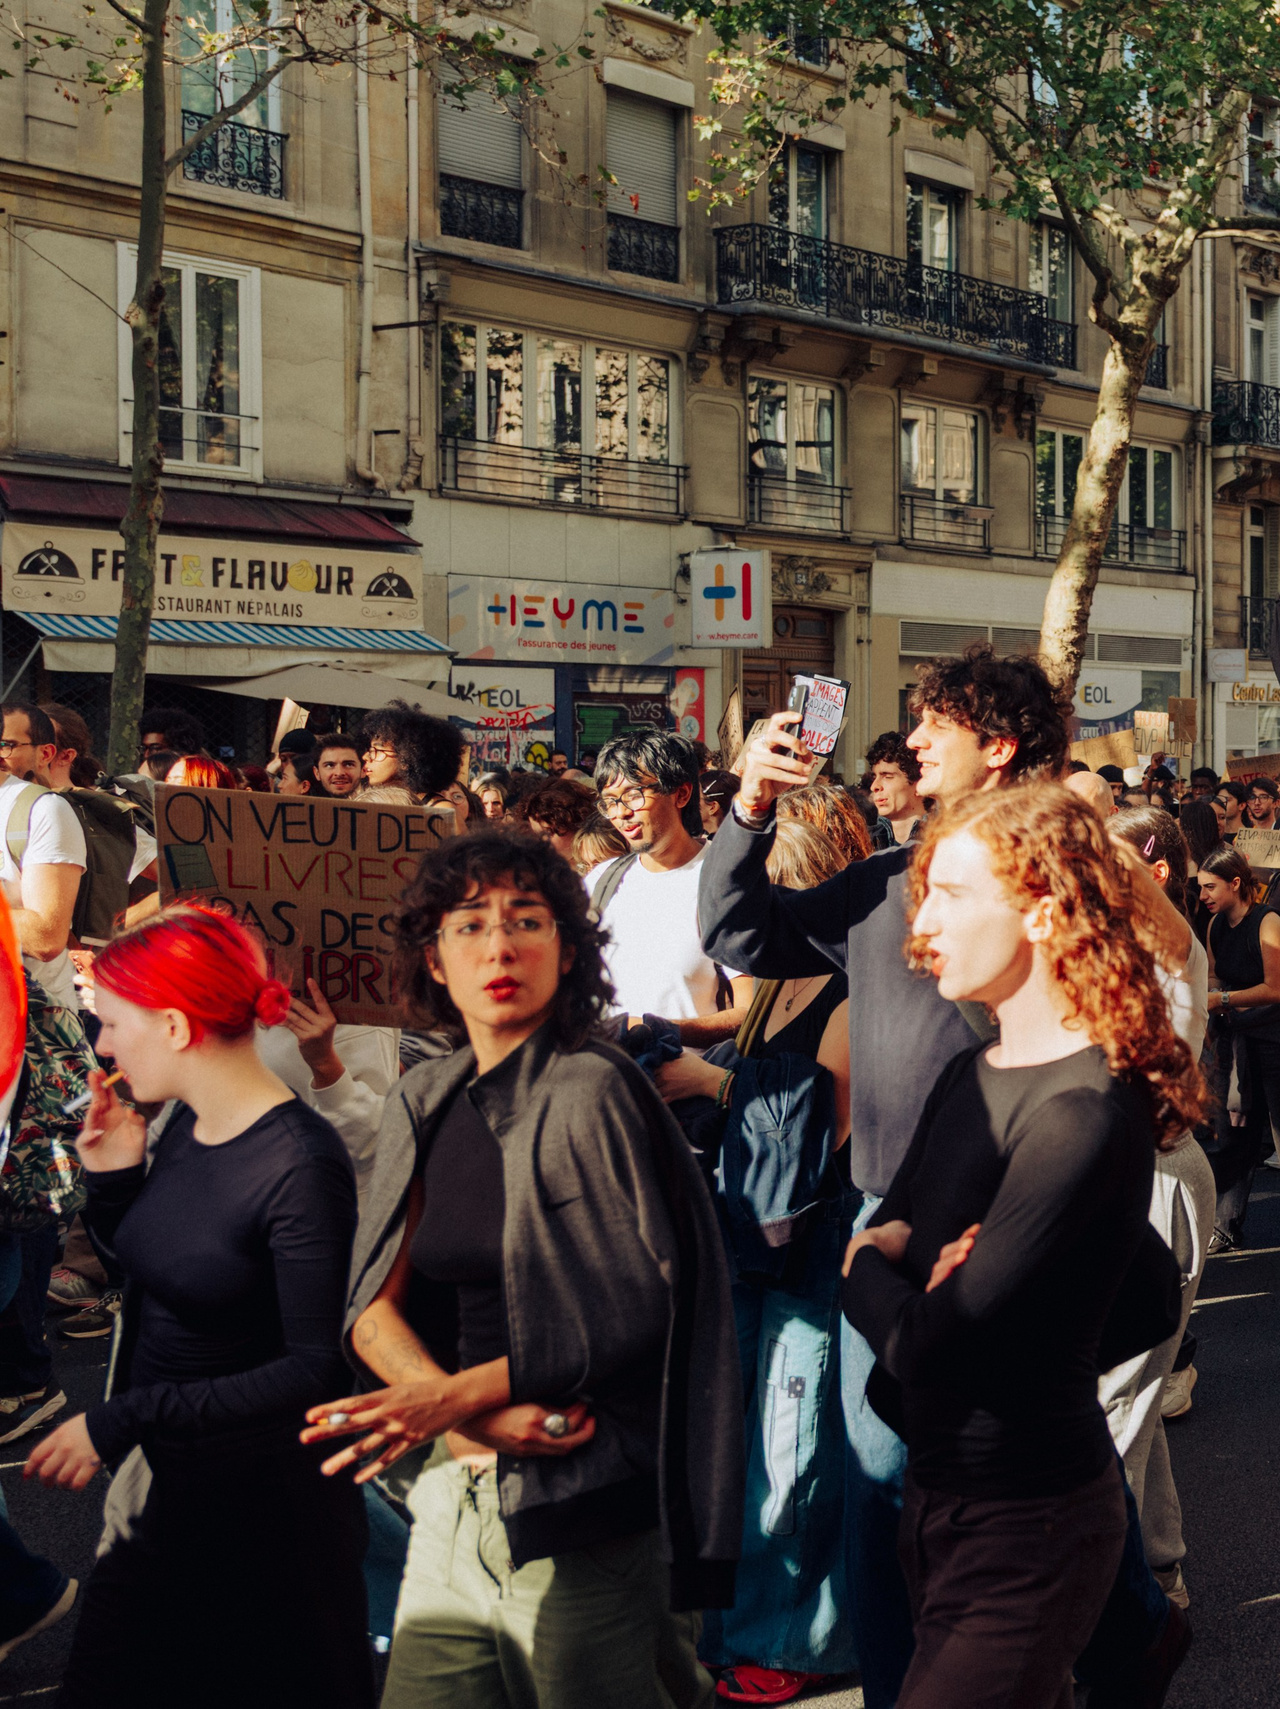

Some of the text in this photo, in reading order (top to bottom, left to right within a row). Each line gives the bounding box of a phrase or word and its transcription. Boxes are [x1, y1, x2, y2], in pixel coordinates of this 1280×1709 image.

[153, 596, 304, 618] STAURANT NÉPALAIS
[518, 637, 616, 652] l'assurance des jeunes
[810, 681, 846, 707] IMAGES
[1232, 682, 1265, 701] Centre
[801, 728, 835, 752] POLICE
[165, 791, 445, 852] ON VEUT DES
